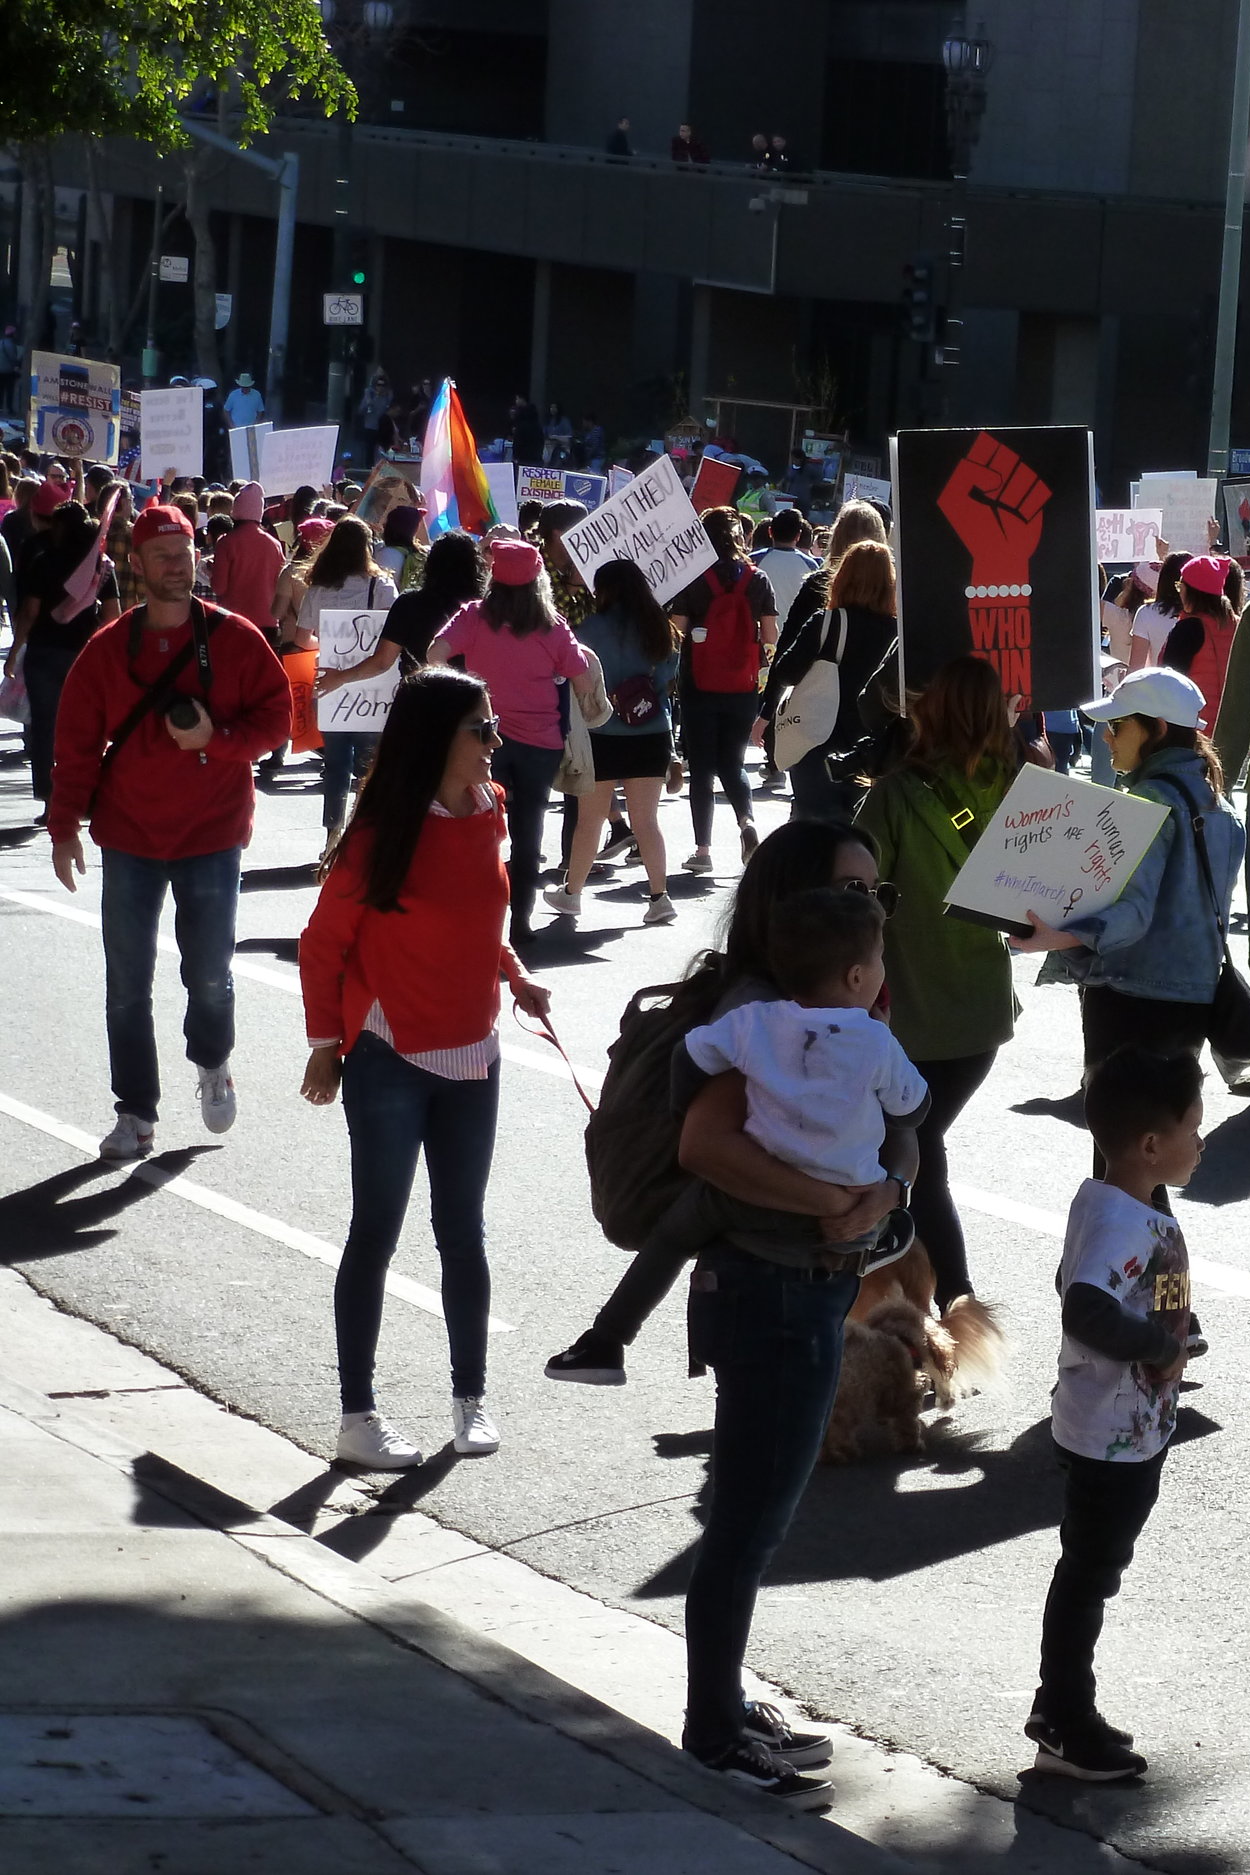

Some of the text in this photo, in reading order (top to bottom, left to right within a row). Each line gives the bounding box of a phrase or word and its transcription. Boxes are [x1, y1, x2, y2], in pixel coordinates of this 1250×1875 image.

[60, 392, 111, 411] #RESIST
[522, 468, 561, 479] RESPECT
[530, 478, 561, 489] FEMALE
[568, 512, 619, 565] BUILD
[642, 518, 706, 589] ND TRUMP
[968, 607, 1031, 650] WHO
[970, 649, 1031, 695] UN
[1004, 827, 1085, 853] rights ARE
[1095, 801, 1126, 865] human
[1081, 839, 1111, 891] rights
